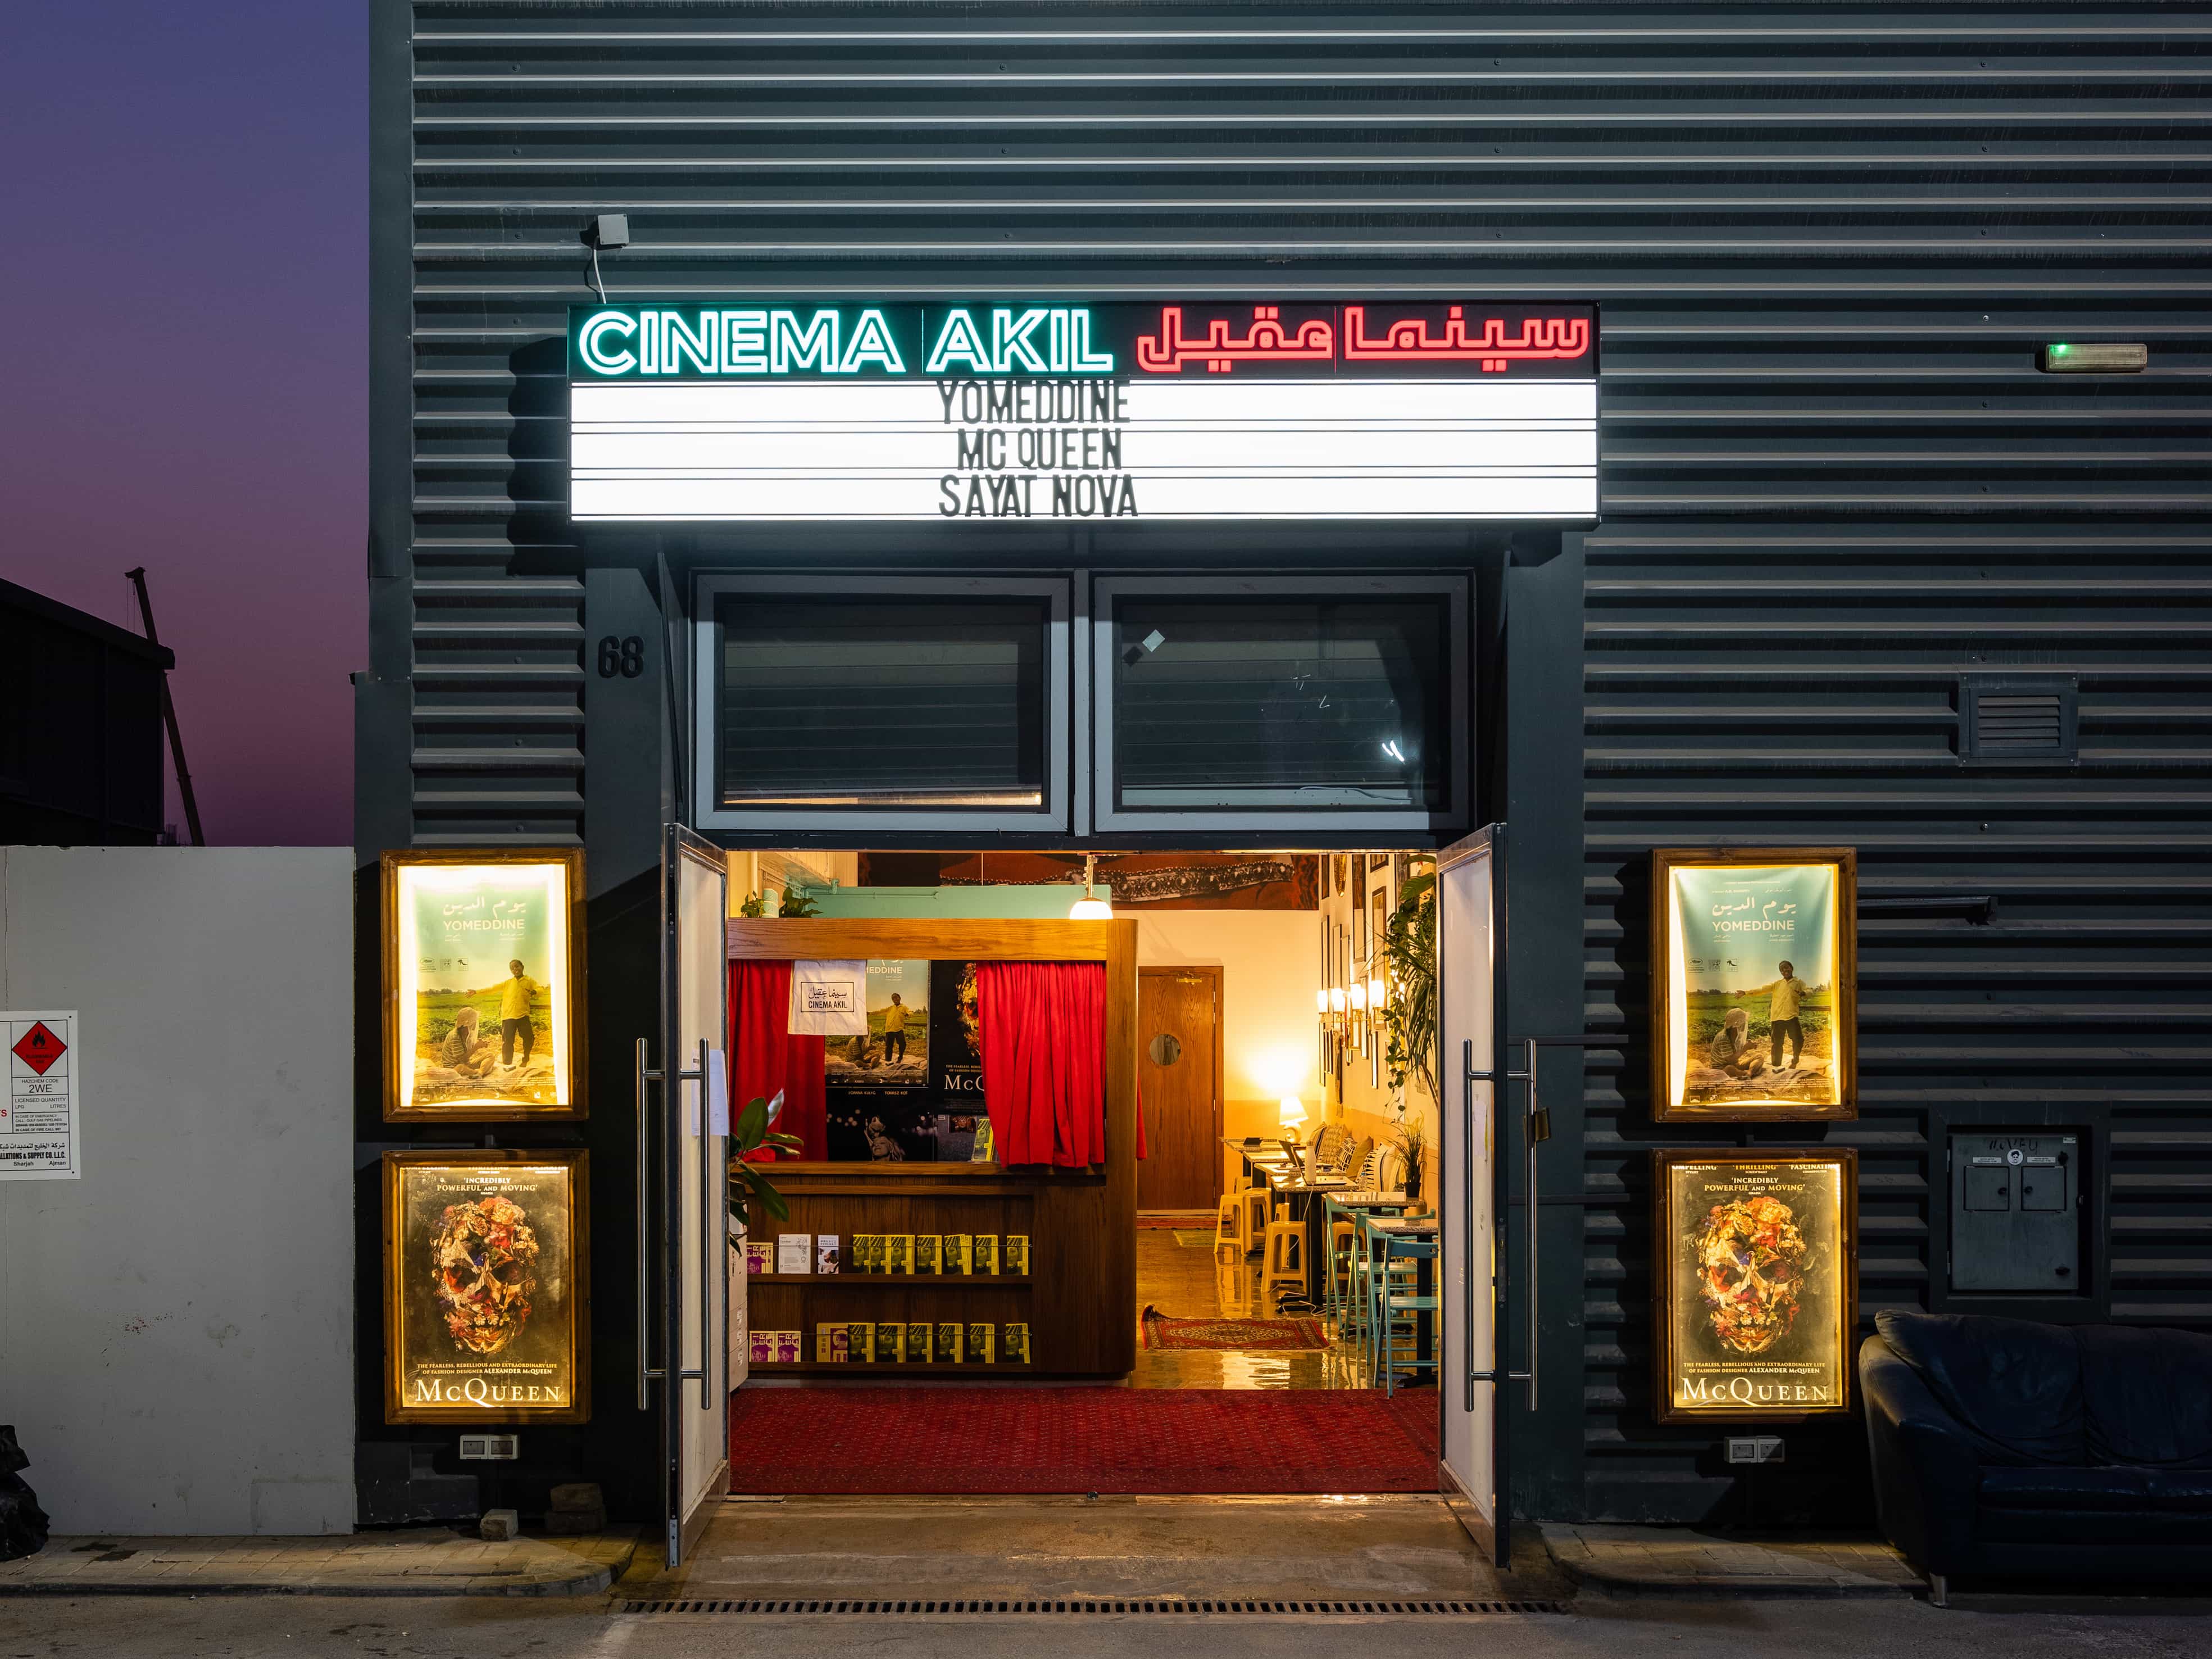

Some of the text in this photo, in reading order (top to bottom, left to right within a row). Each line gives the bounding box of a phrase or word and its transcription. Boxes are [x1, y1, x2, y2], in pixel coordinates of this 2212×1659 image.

[579, 310, 1114, 375] CINEMA AKIL
[1138, 306, 1589, 372] سينما عقيل
[938, 380, 1130, 423] YOMEDDINE
[957, 429, 1121, 470] MC QUEEN
[939, 475, 1138, 517] SAYAT NOVA
[598, 636, 644, 678] 68
[443, 896, 526, 919] يوم الدين
[443, 919, 525, 931] YOMEDDINE
[1712, 896, 1797, 920] يوم الدين
[1712, 920, 1795, 931] YOMEDDINE
[29, 1084, 52, 1093] 2WE
